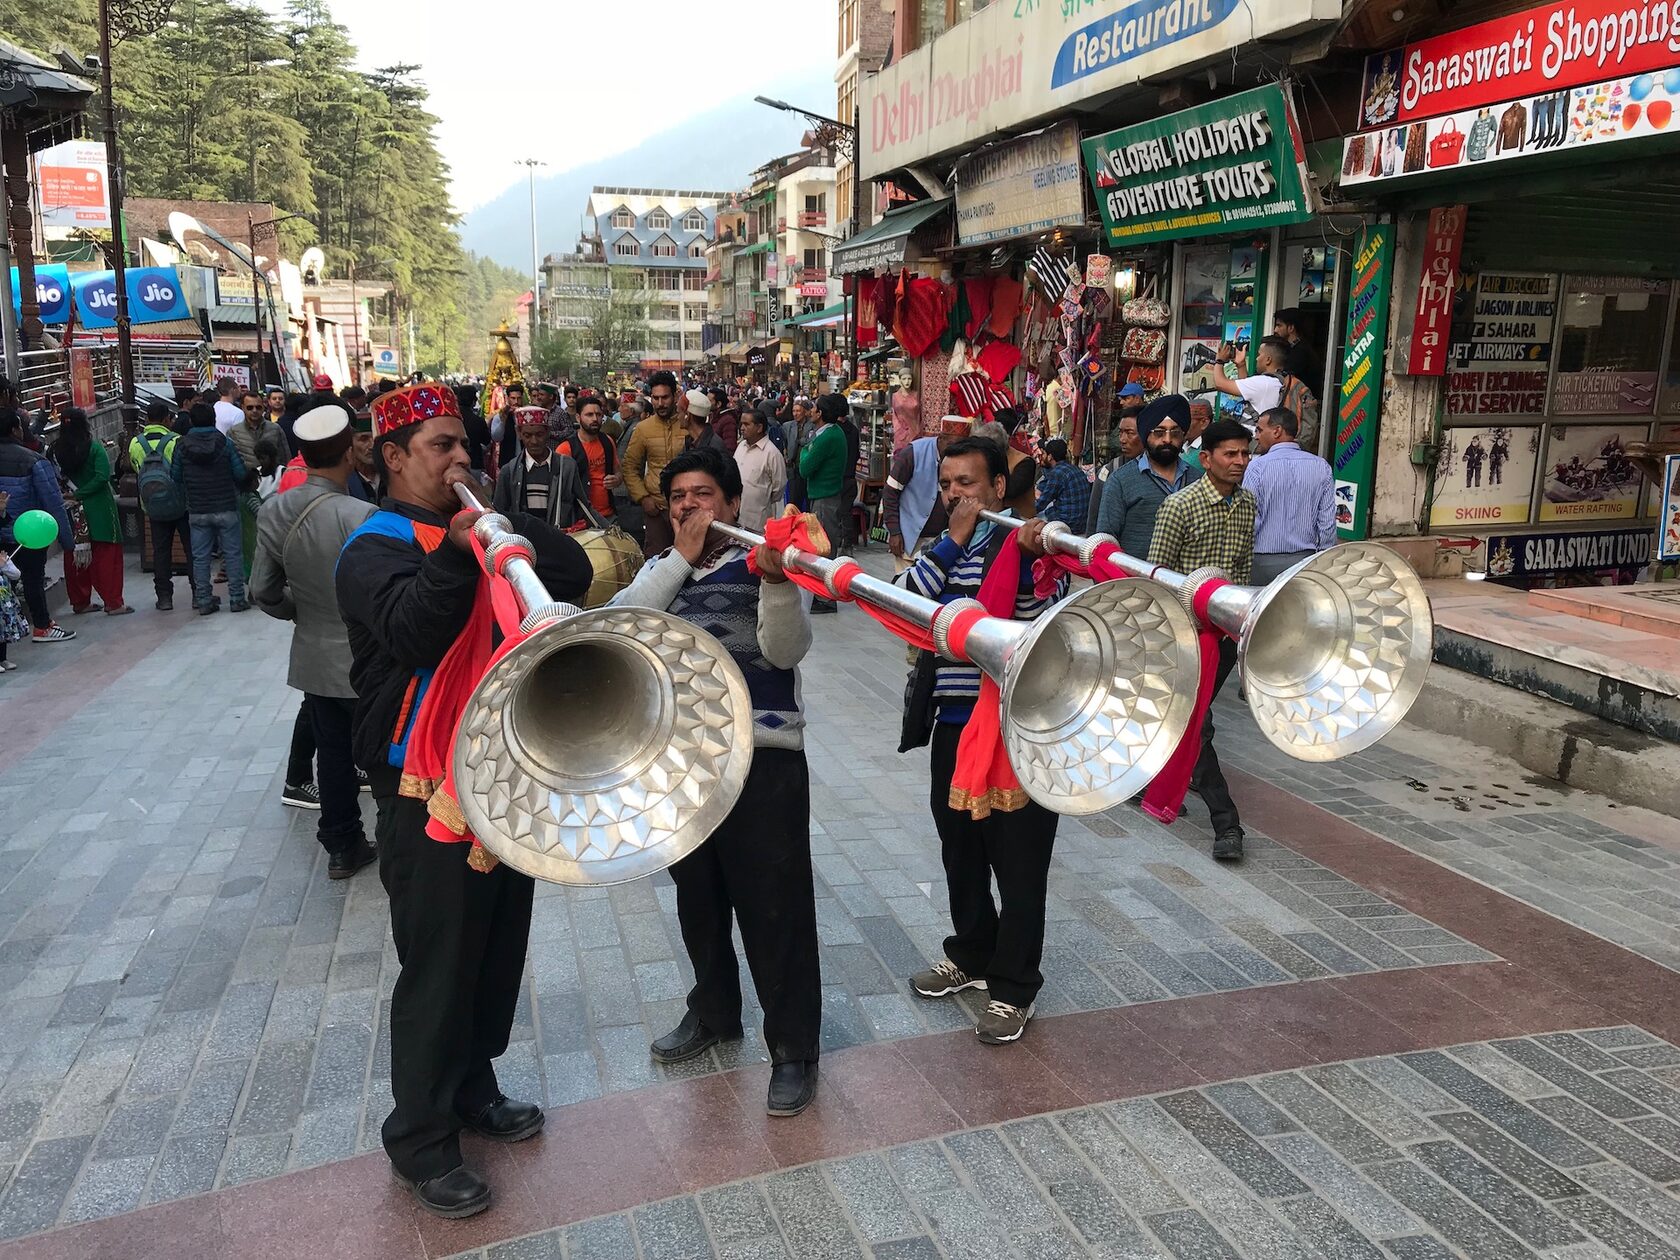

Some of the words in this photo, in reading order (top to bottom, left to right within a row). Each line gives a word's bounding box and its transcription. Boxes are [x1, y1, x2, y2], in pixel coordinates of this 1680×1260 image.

[1073, 0, 1213, 75] Restaurant
[1403, 19, 1535, 110] Saraswati
[1542, 0, 1680, 79] Shopping
[872, 73, 925, 154] Delhi
[928, 32, 1025, 130] Mughlai
[1109, 136, 1172, 179] GLOBAL
[1172, 110, 1270, 168] HOLIDAYS
[1055, 163, 1078, 182] STONES
[1107, 174, 1204, 222] ADVENTURE
[1204, 160, 1273, 204] TOURS
[144, 283, 174, 302] Jio
[801, 287, 827, 295] TATTOO
[1481, 276, 1501, 293] AIR
[1505, 278, 1549, 294] DECCAN
[1475, 300, 1513, 316] JAGSON
[1515, 301, 1554, 316] AIRLINES
[1487, 322, 1536, 338] SAHARA
[1344, 331, 1376, 369] KATRA
[1449, 343, 1472, 359] JET
[1473, 344, 1526, 360] AIRWAYS
[217, 366, 244, 375] NAC
[1485, 371, 1548, 392] EXCHANGE
[1554, 376, 1571, 393] AIR
[1574, 375, 1621, 393] TICKETING
[1479, 392, 1544, 414] SERVICE
[1455, 506, 1502, 520] SKIING
[1555, 505, 1587, 515] WATER
[1587, 503, 1623, 514] RAFTING
[1524, 535, 1616, 571] SARASWATI
[1617, 533, 1655, 565] UND
